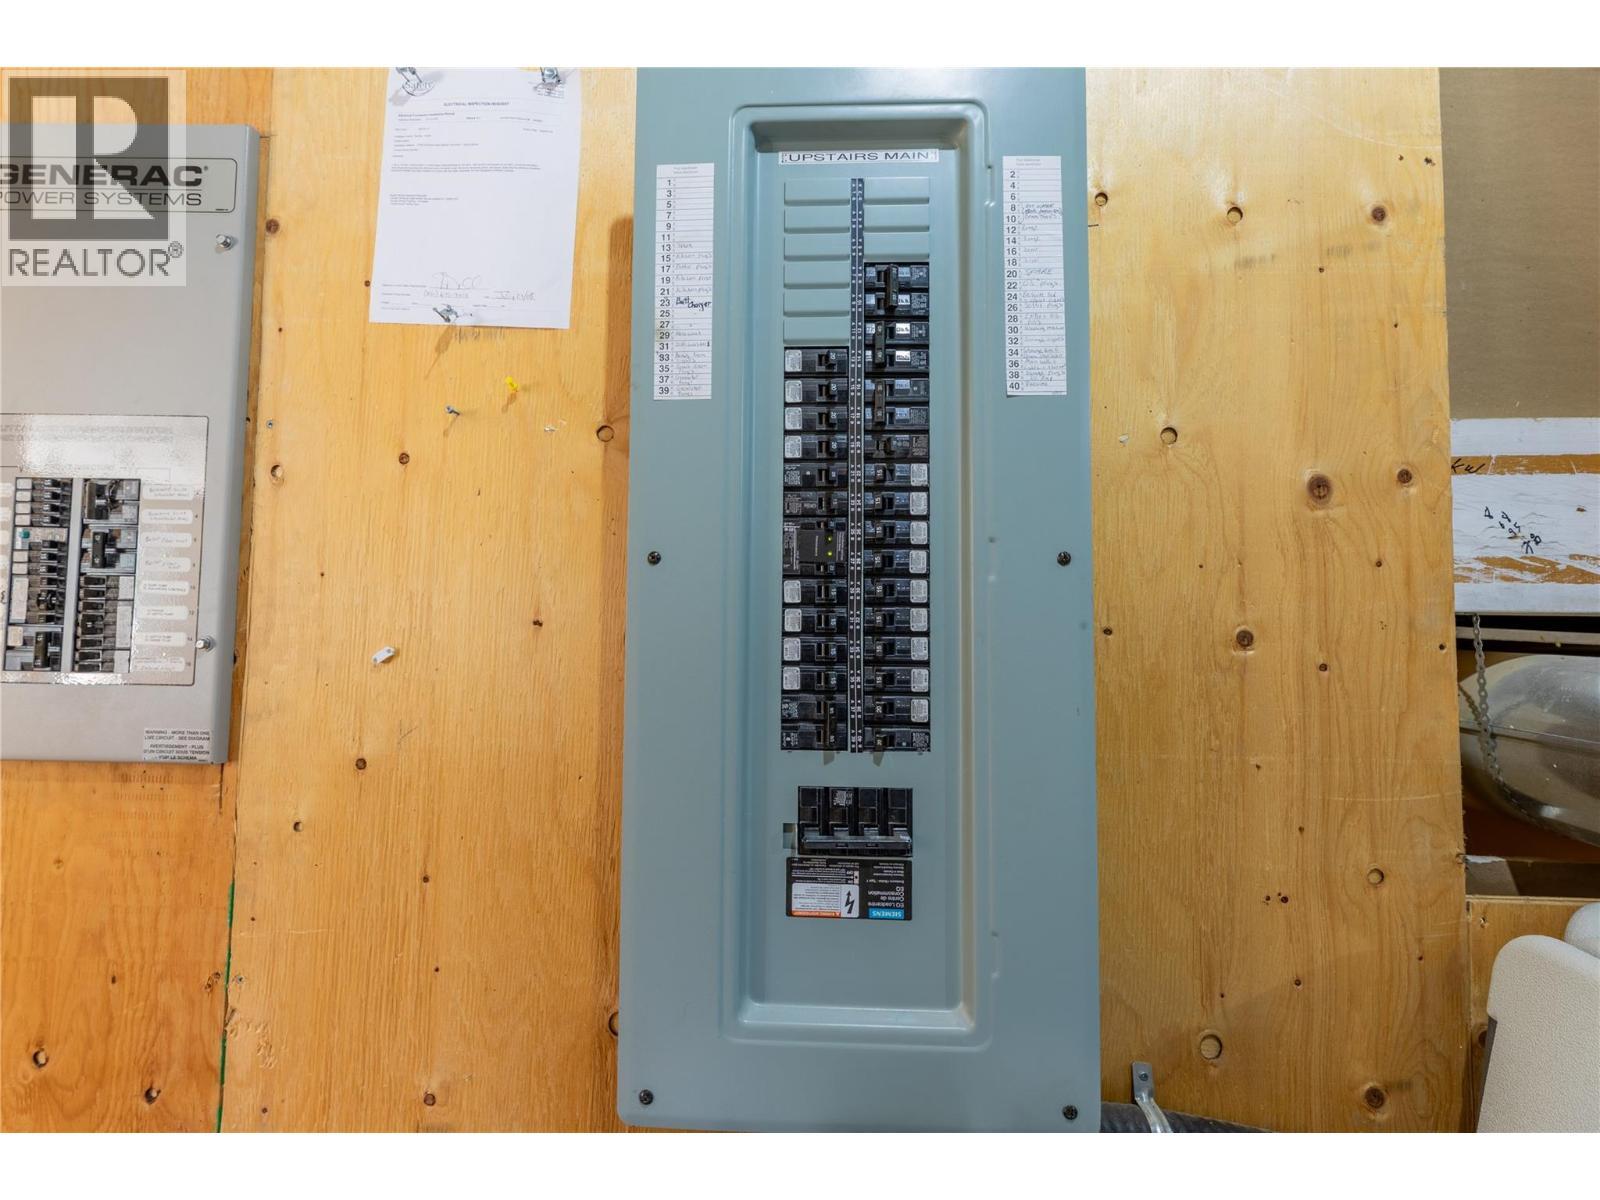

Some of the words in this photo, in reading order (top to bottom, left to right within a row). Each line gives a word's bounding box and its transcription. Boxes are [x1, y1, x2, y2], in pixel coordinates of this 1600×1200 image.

[788, 152, 879, 162] UPSTAIRS
[884, 151, 929, 160] MAIN
[84, 190, 202, 206] SYSTEMS
[1008, 326, 1018, 334] 30
